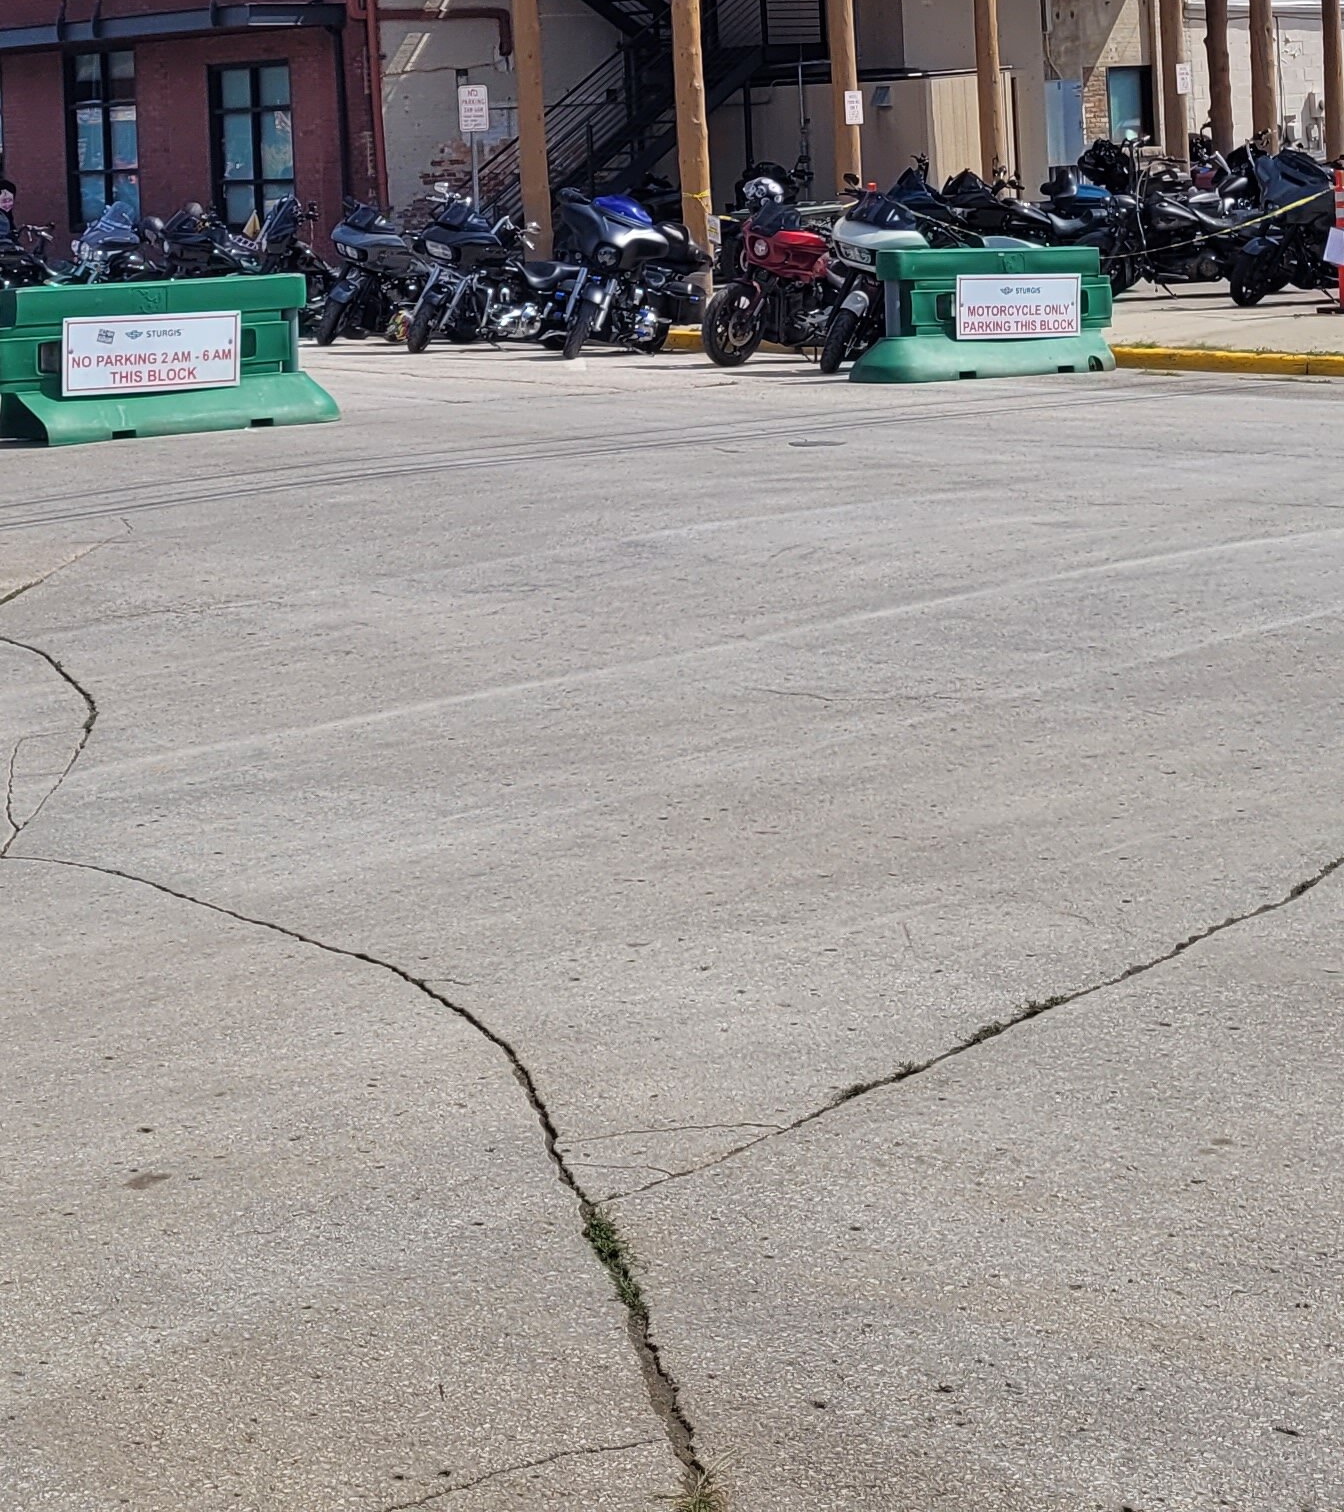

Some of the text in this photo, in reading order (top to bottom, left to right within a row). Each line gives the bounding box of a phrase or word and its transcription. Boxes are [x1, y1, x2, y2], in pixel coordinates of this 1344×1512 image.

[1015, 287, 1041, 295] STURGIS
[967, 304, 1069, 317] MOTORCYCLE ONLY
[963, 319, 1074, 332] PARKING THIS BLOCK
[146, 329, 182, 338] STURGIS
[72, 356, 92, 368] NO
[96, 352, 156, 367] PARKING
[161, 352, 168, 364] 2
[171, 350, 191, 363] AM
[202, 350, 209, 361] 6
[212, 348, 232, 361] AM
[110, 367, 197, 384] THIS BLOCK
